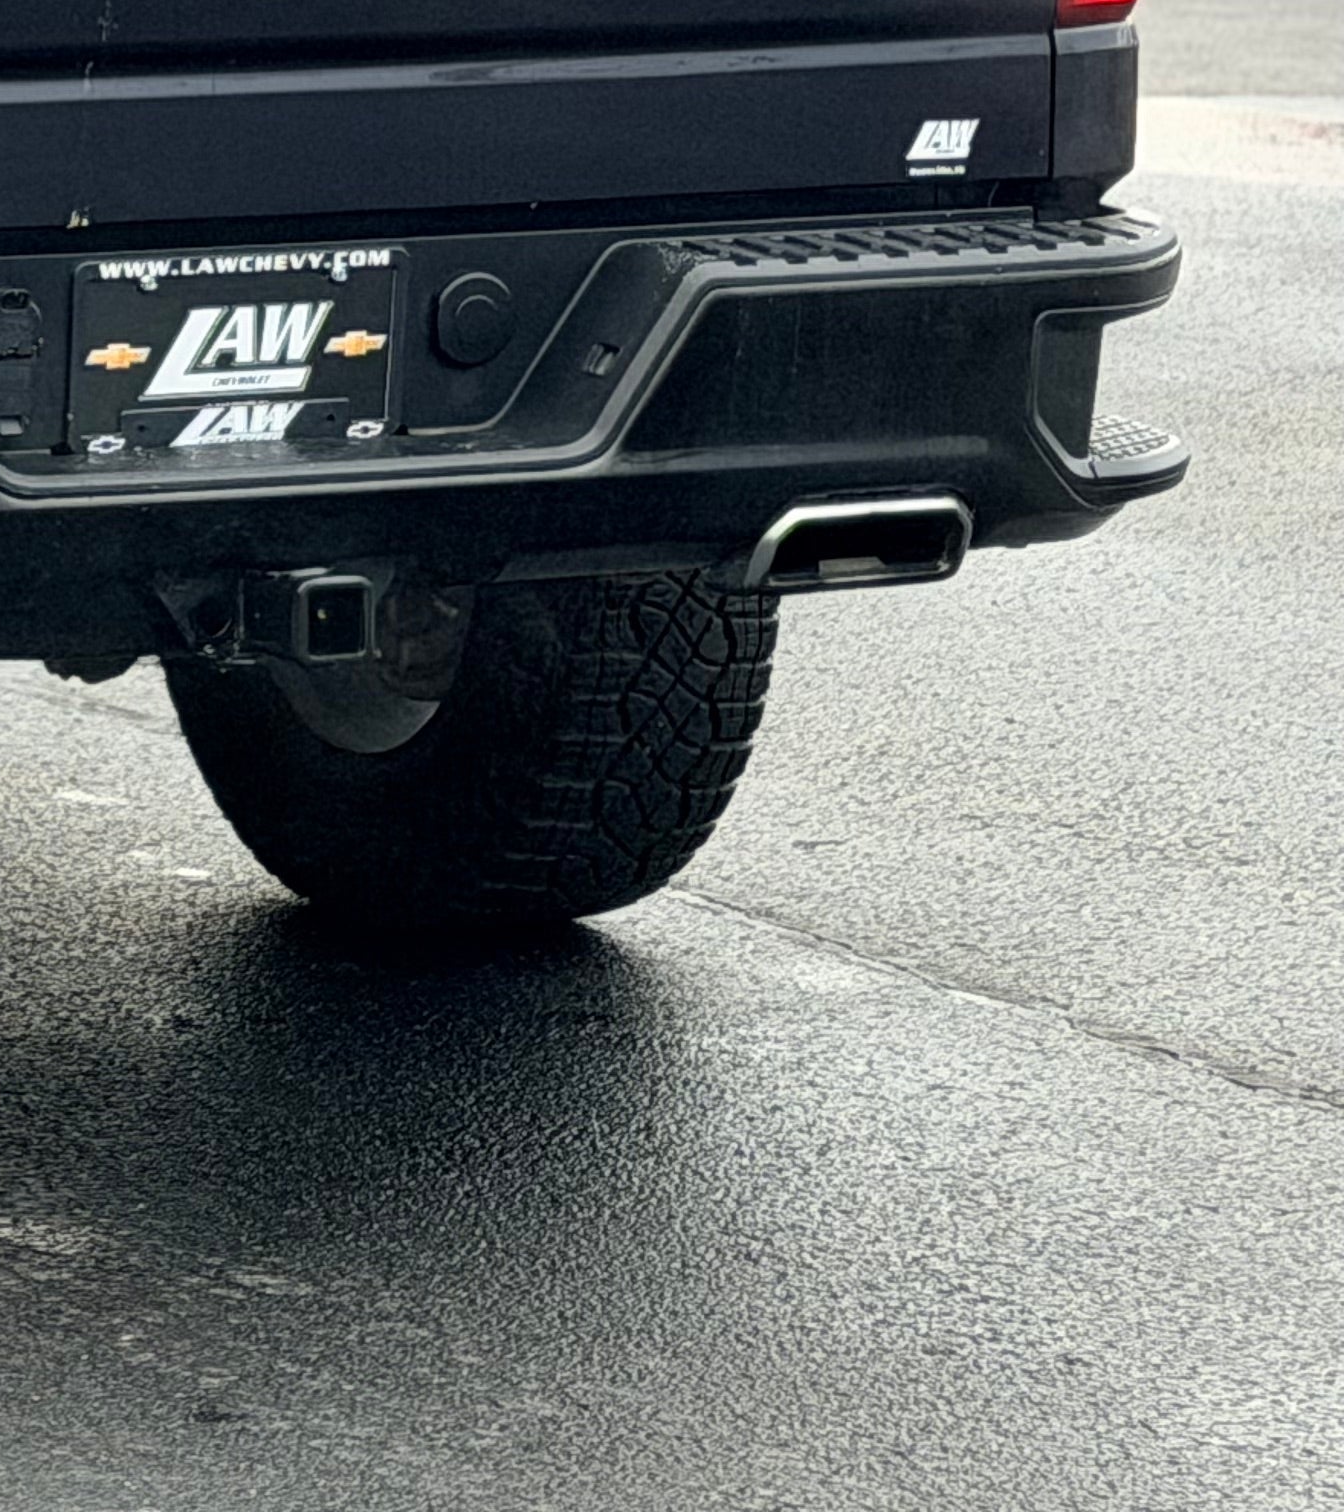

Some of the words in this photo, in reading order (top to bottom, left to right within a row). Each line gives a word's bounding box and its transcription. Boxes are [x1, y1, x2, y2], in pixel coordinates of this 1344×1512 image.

[906, 118, 980, 161] LAW
[99, 249, 391, 279] WWW.LAWCHEVY.COM
[138, 300, 334, 401] LAW
[169, 401, 306, 448] LAW
